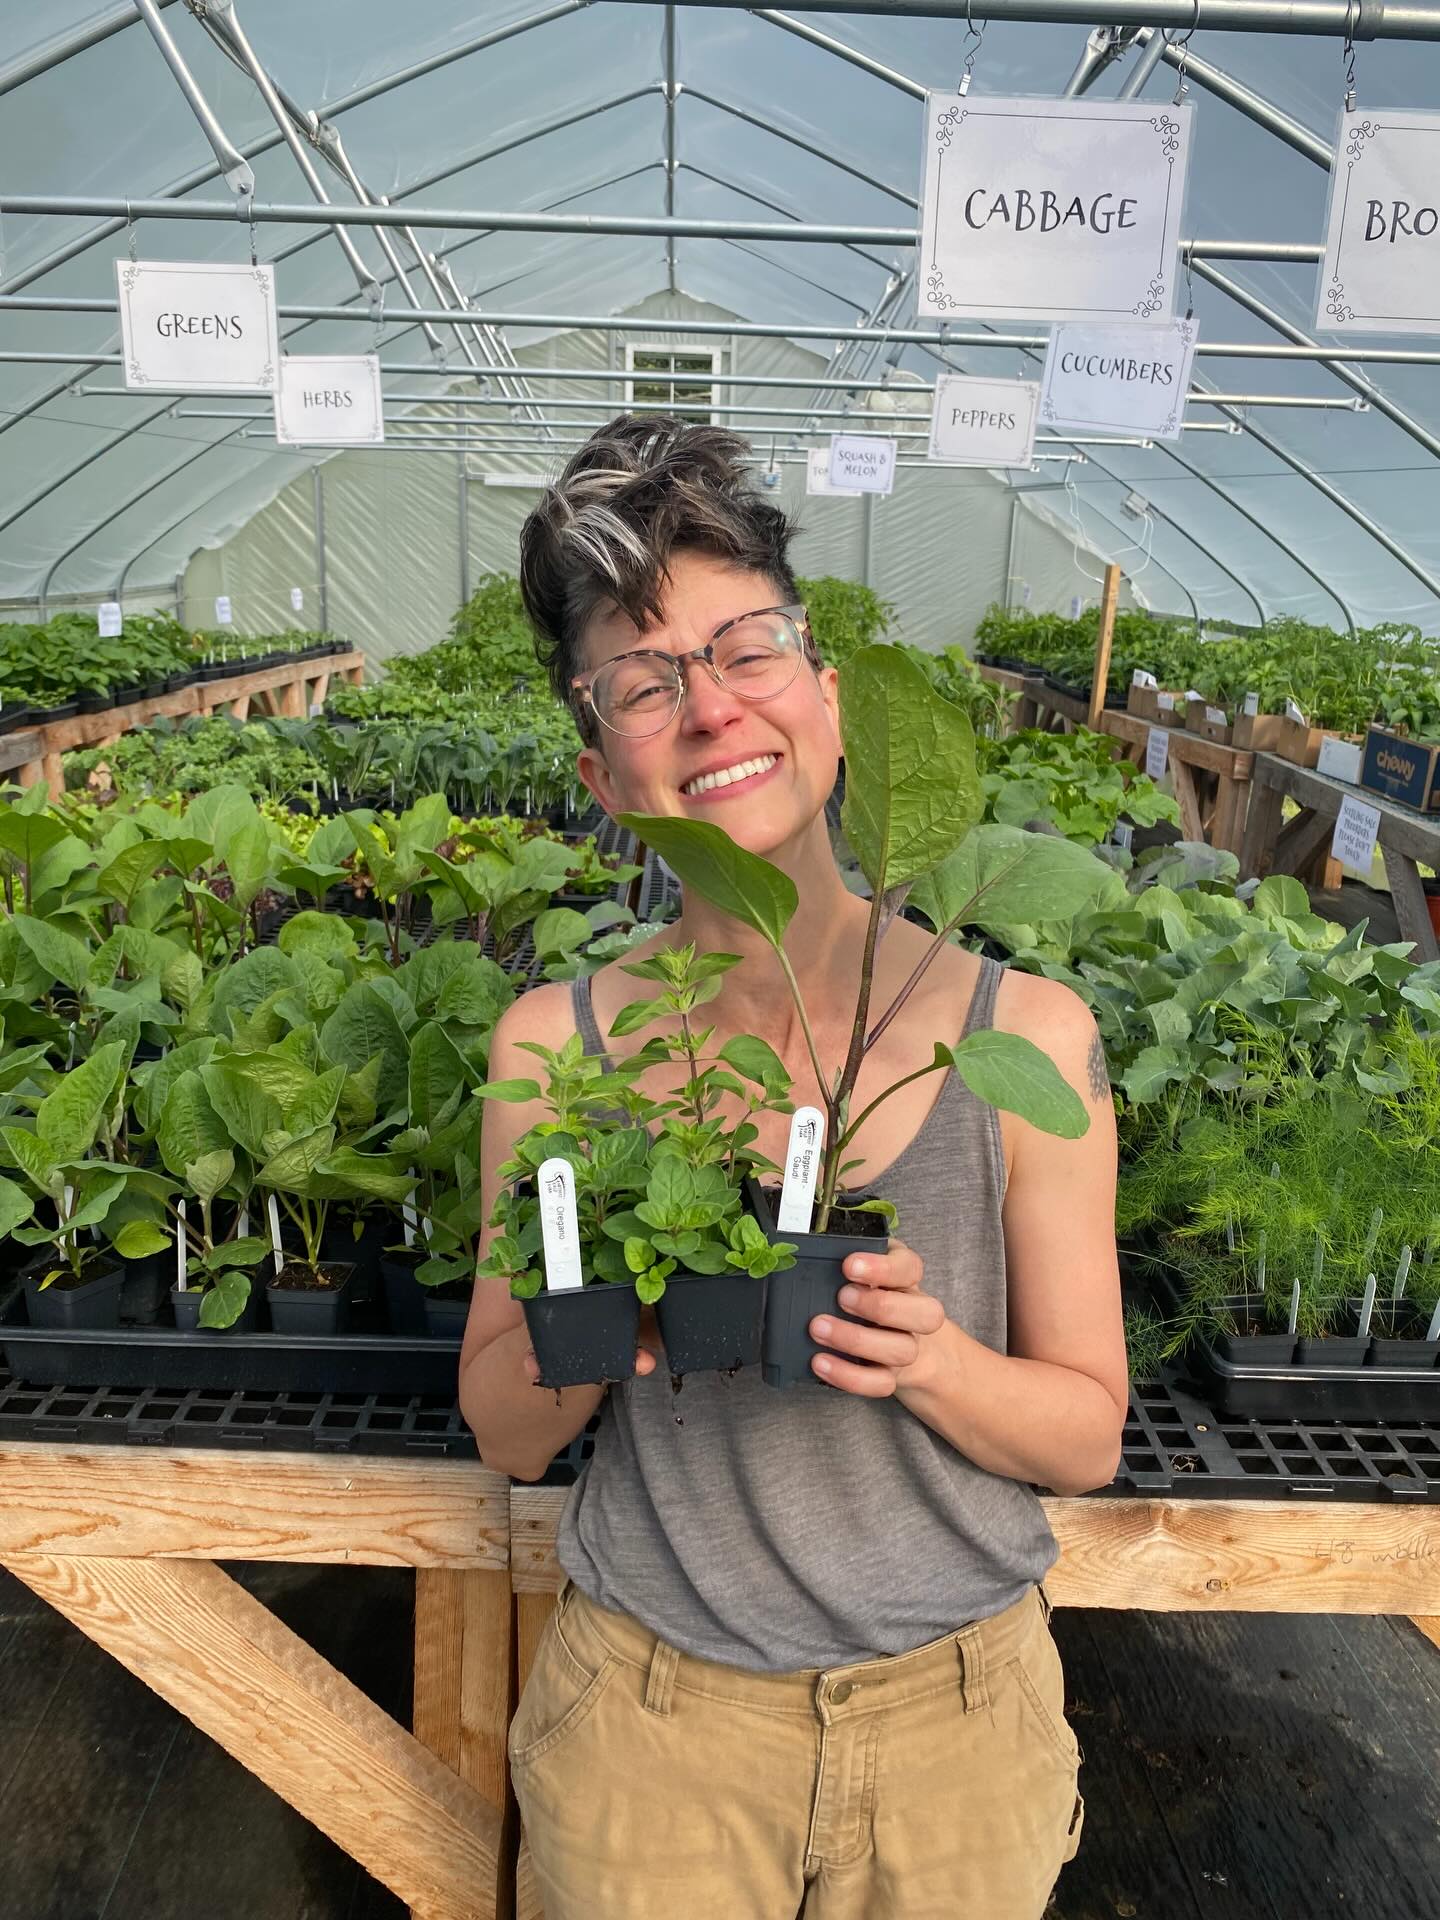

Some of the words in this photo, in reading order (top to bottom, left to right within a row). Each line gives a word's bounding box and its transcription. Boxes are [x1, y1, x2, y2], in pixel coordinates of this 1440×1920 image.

[964, 189, 1138, 234] CABBAGE
[1364, 199, 1439, 243] BRO
[156, 313, 243, 339] GREENS
[1061, 352, 1174, 386] CUCUMBERS
[303, 390, 353, 409] HERBS
[951, 408, 1016, 431] PEPPERS
[839, 450, 877, 464] SQUASH
[843, 464, 877, 477] MELON
[1376, 749, 1416, 781] chewy
[802, 1149, 813, 1184] Eggplant
[556, 1206, 566, 1240] Oregano
